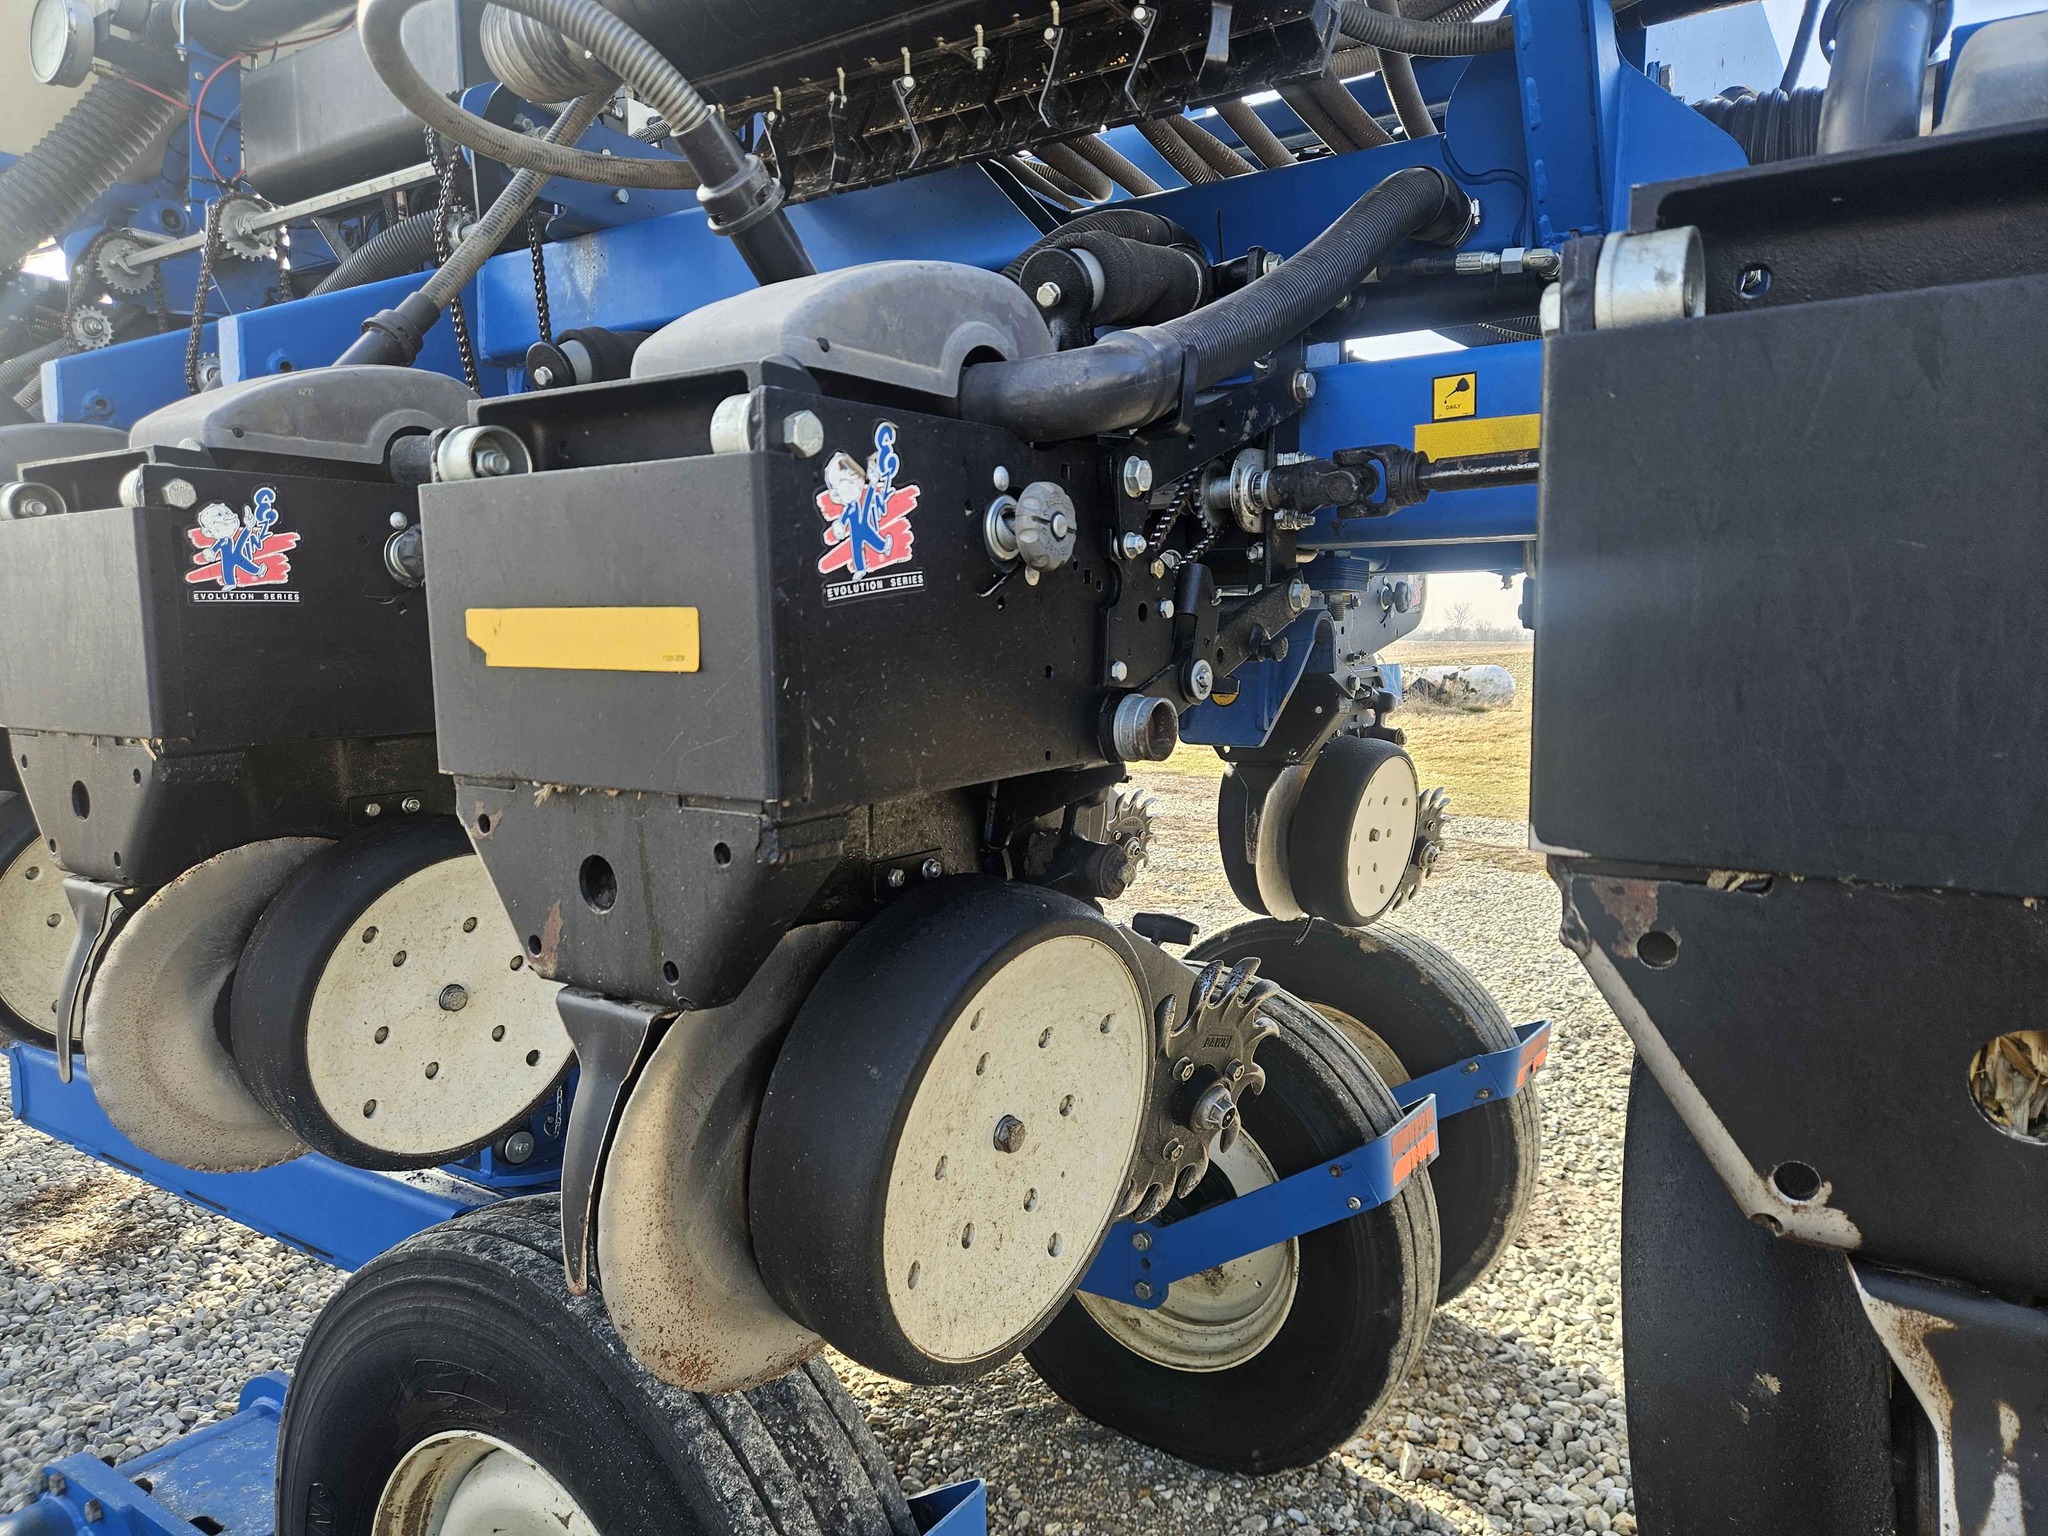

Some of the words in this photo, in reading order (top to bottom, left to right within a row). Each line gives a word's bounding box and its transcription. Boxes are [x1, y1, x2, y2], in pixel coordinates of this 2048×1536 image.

[826, 580, 884, 598] EVOLUTION
[890, 574, 924, 589] SERIES
[263, 593, 300, 601] SERIES
